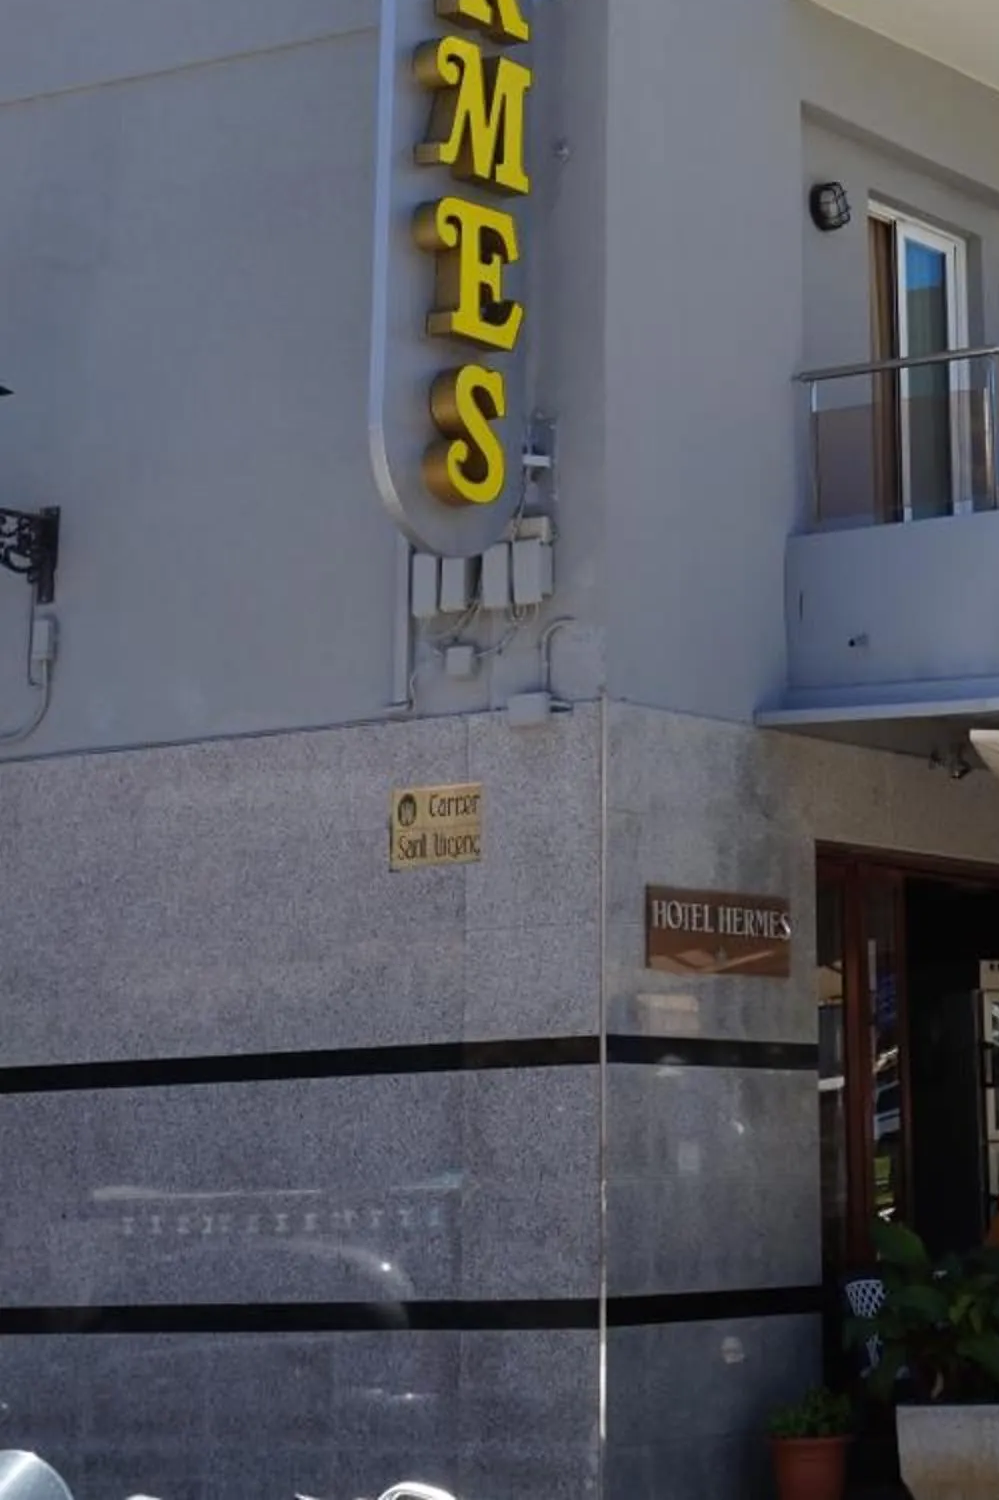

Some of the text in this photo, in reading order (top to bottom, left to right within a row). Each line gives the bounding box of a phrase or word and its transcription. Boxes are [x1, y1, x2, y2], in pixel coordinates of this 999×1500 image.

[428, 793, 481, 817] Carrer
[398, 833, 427, 861] Sant
[651, 899, 792, 941] HOTEL HERMES
